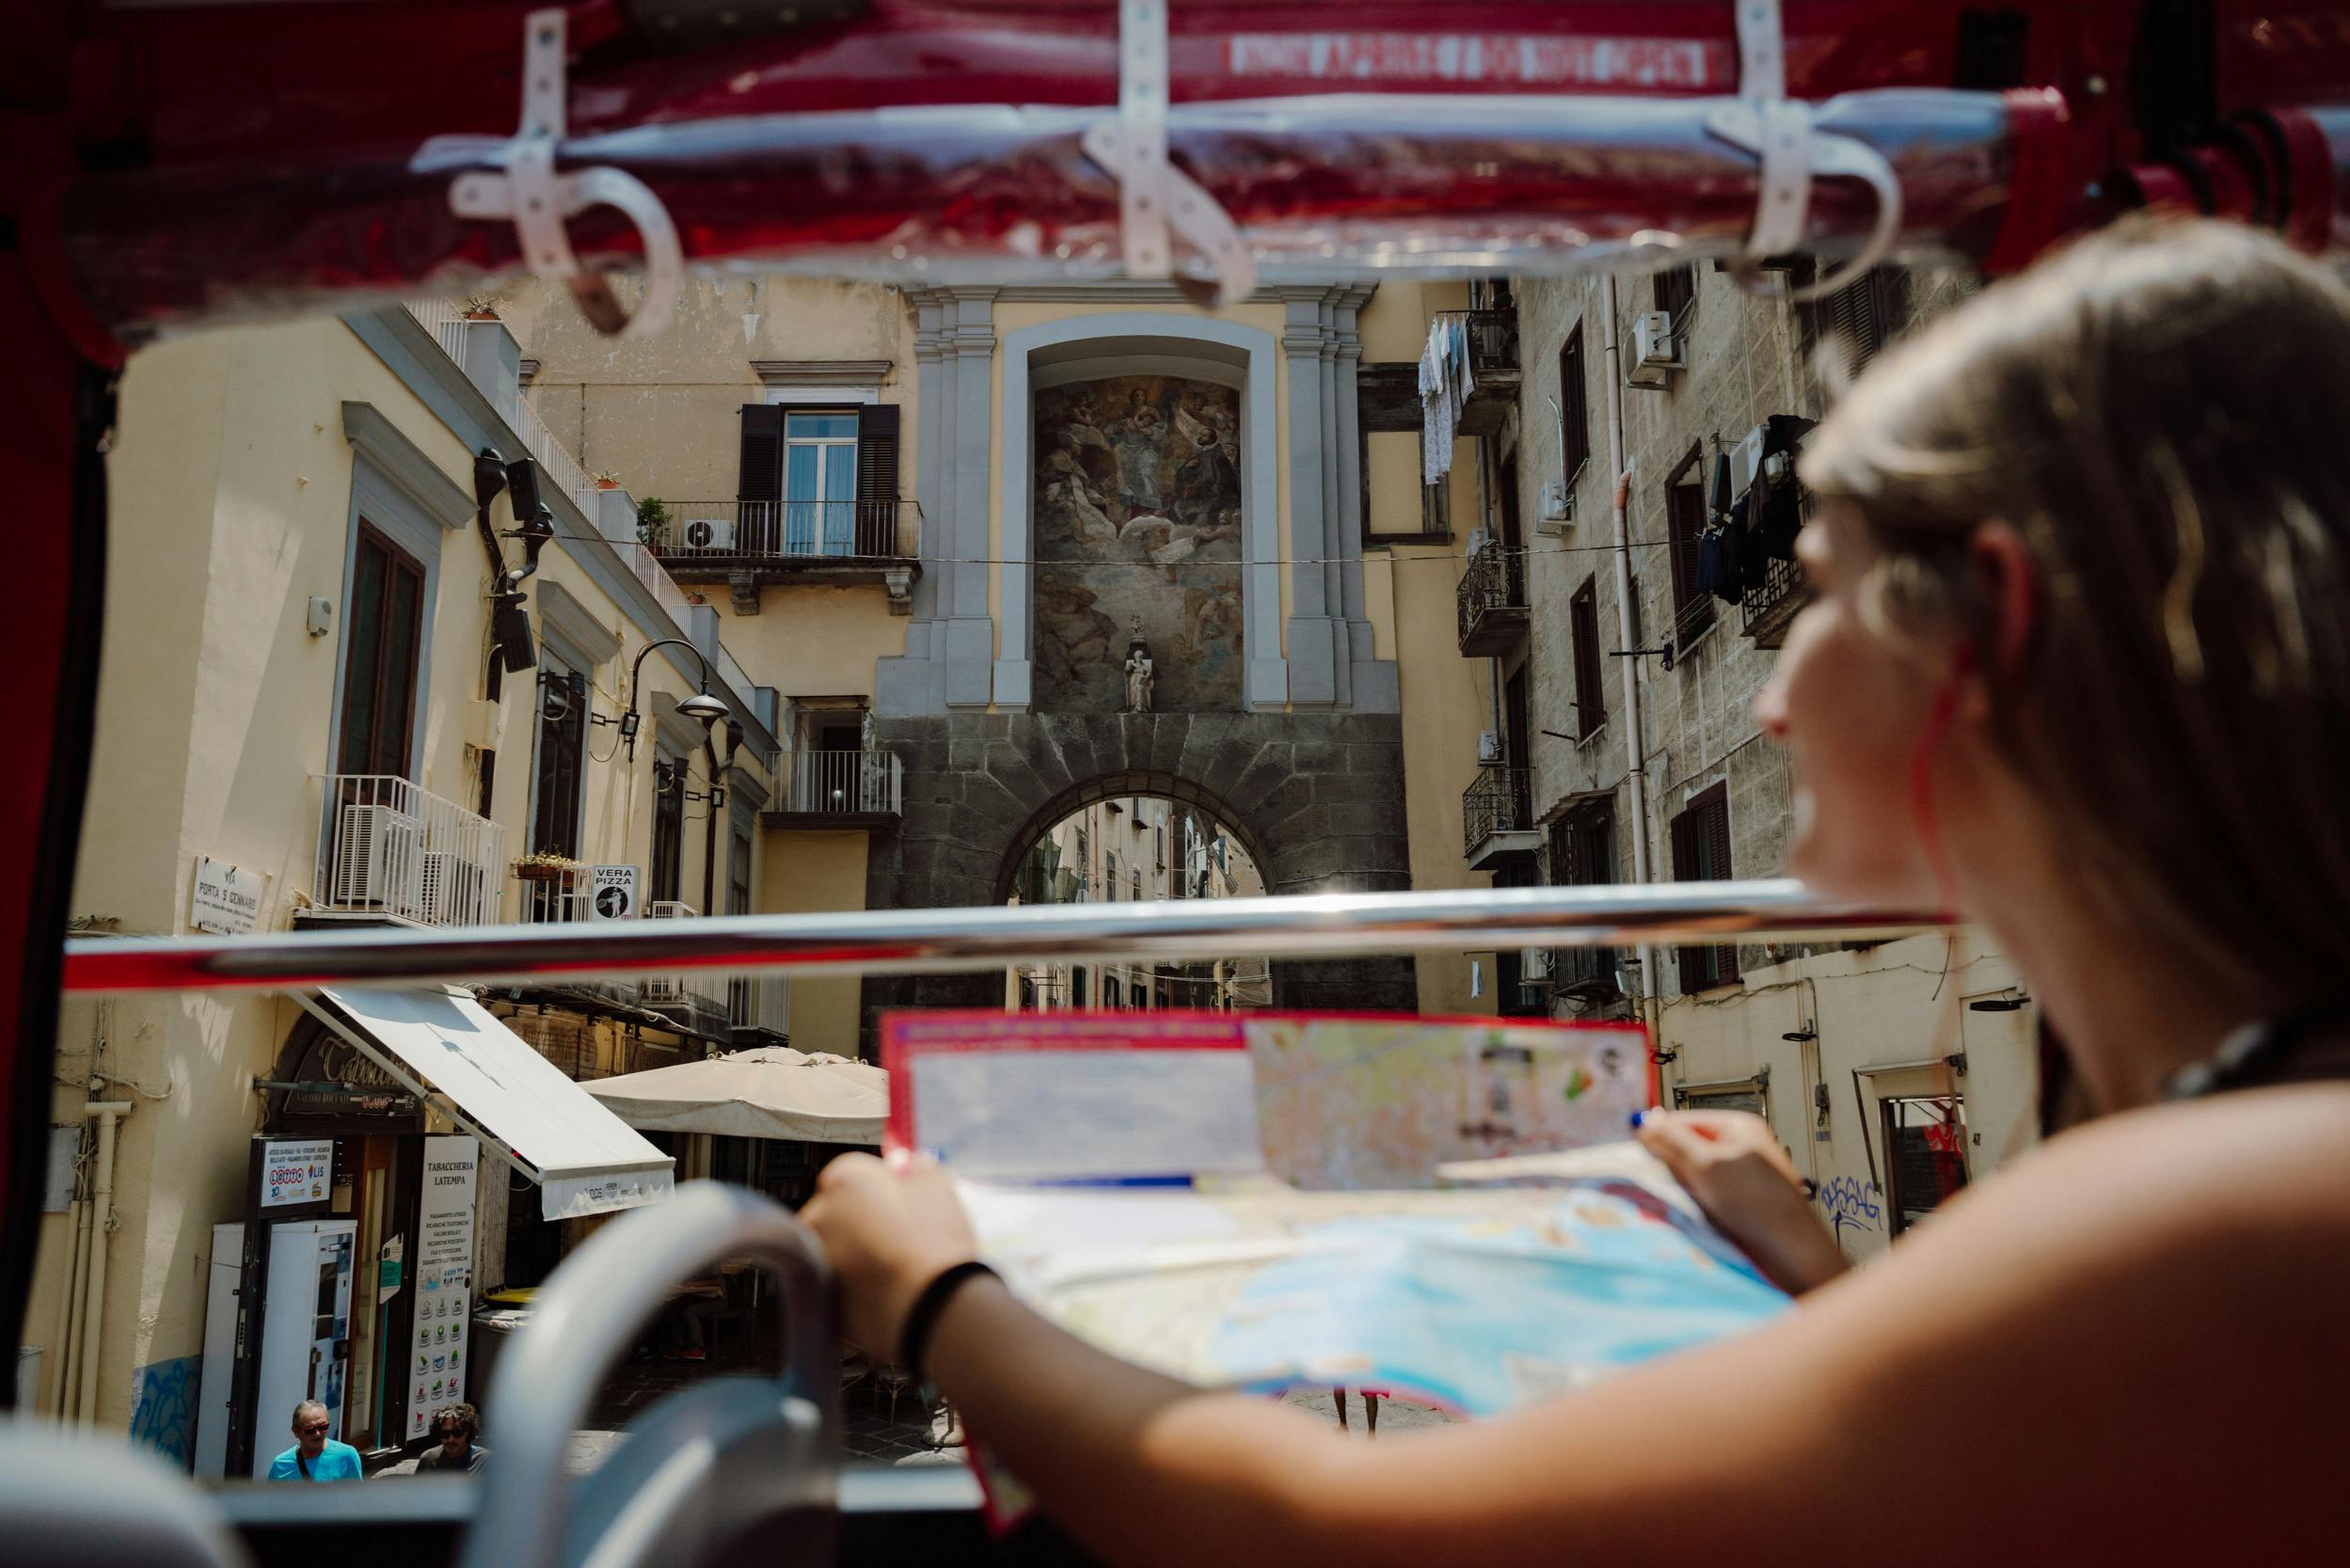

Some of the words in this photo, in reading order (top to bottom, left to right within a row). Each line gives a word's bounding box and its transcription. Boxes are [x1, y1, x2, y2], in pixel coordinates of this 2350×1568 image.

[225, 871, 235, 884] VIA
[198, 881, 219, 898] PORTA
[230, 891, 256, 911] GENNARO
[313, 1166, 324, 1178] LIS
[427, 1162, 474, 1172] TABACCHERIA
[435, 1176, 466, 1186] LATEMPA
